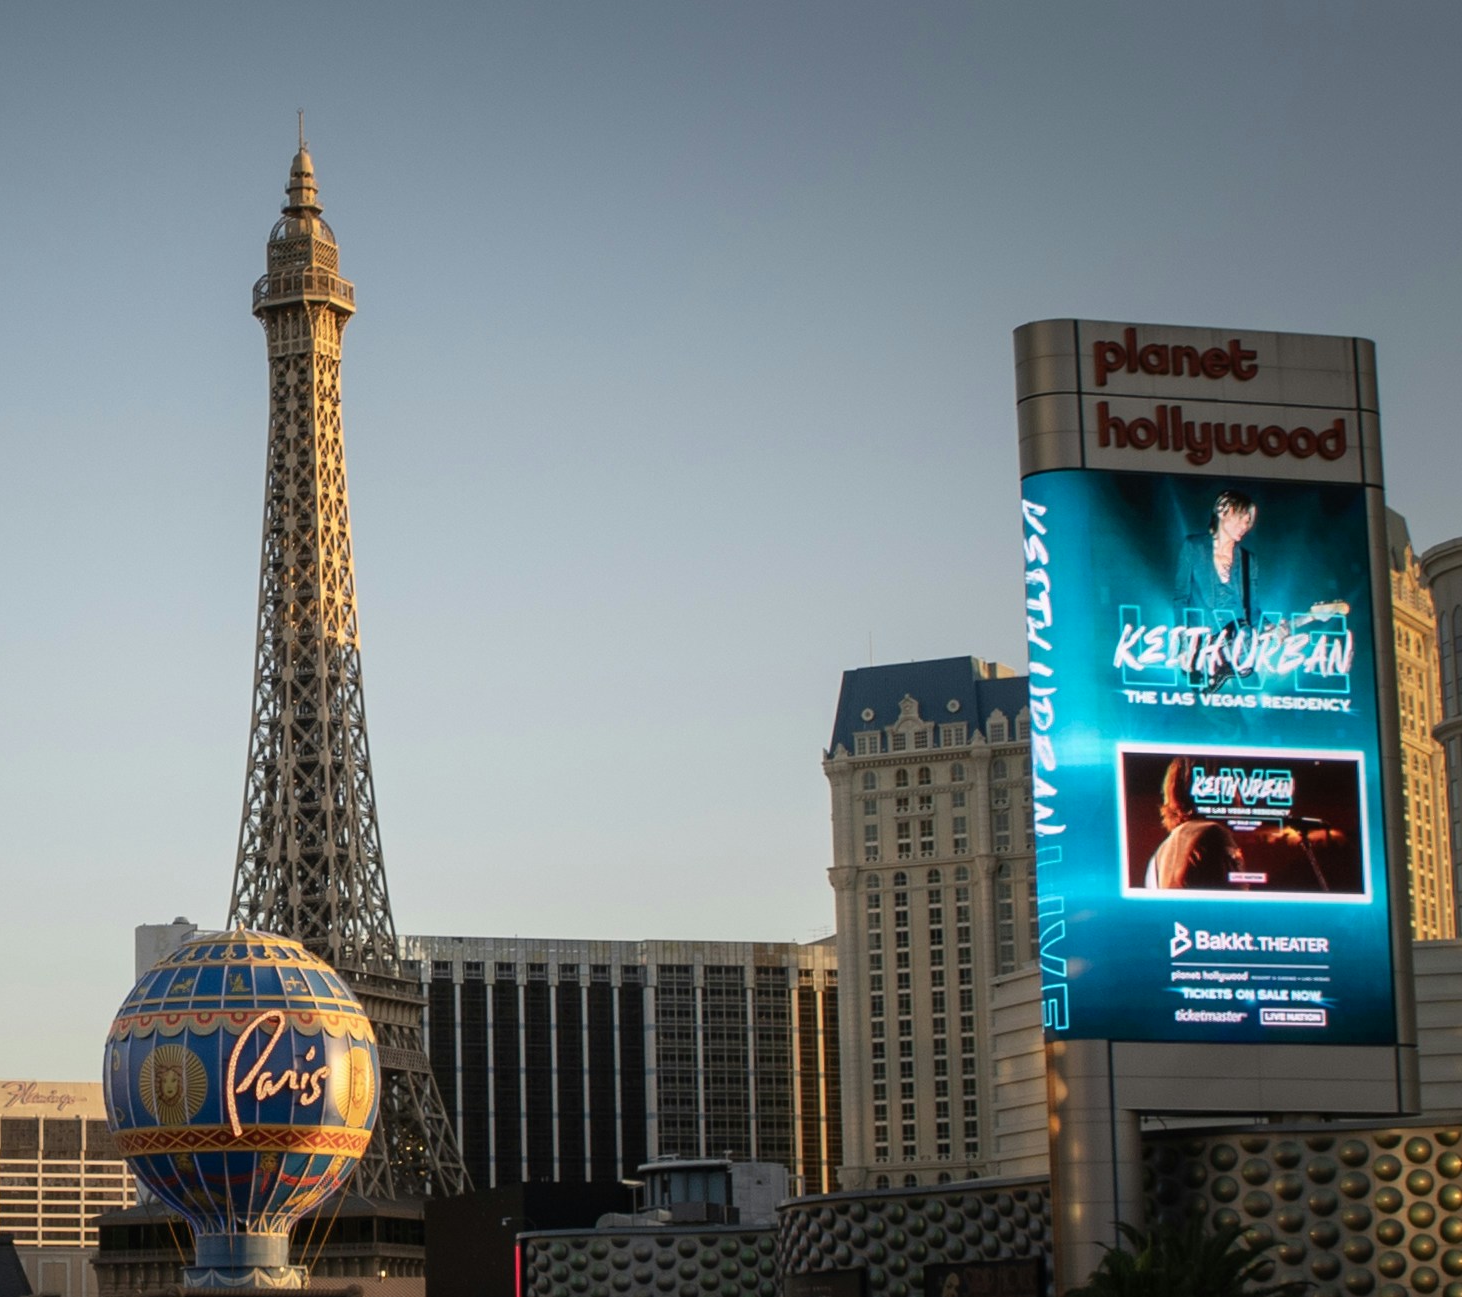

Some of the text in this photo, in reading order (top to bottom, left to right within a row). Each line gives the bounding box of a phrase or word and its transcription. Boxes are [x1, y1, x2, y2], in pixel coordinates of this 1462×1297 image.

[1094, 327, 1258, 386] planet
[1097, 401, 1347, 465] hollywood
[1113, 623, 1354, 677] KEITH URBAN
[1127, 690, 1351, 712] THE LAS VEGAS RESIDENCY
[1258, 937, 1329, 953] THEATER
[1182, 987, 1322, 1002] TICKETS ON SALE NOW
[226, 1009, 331, 1137] Paris
